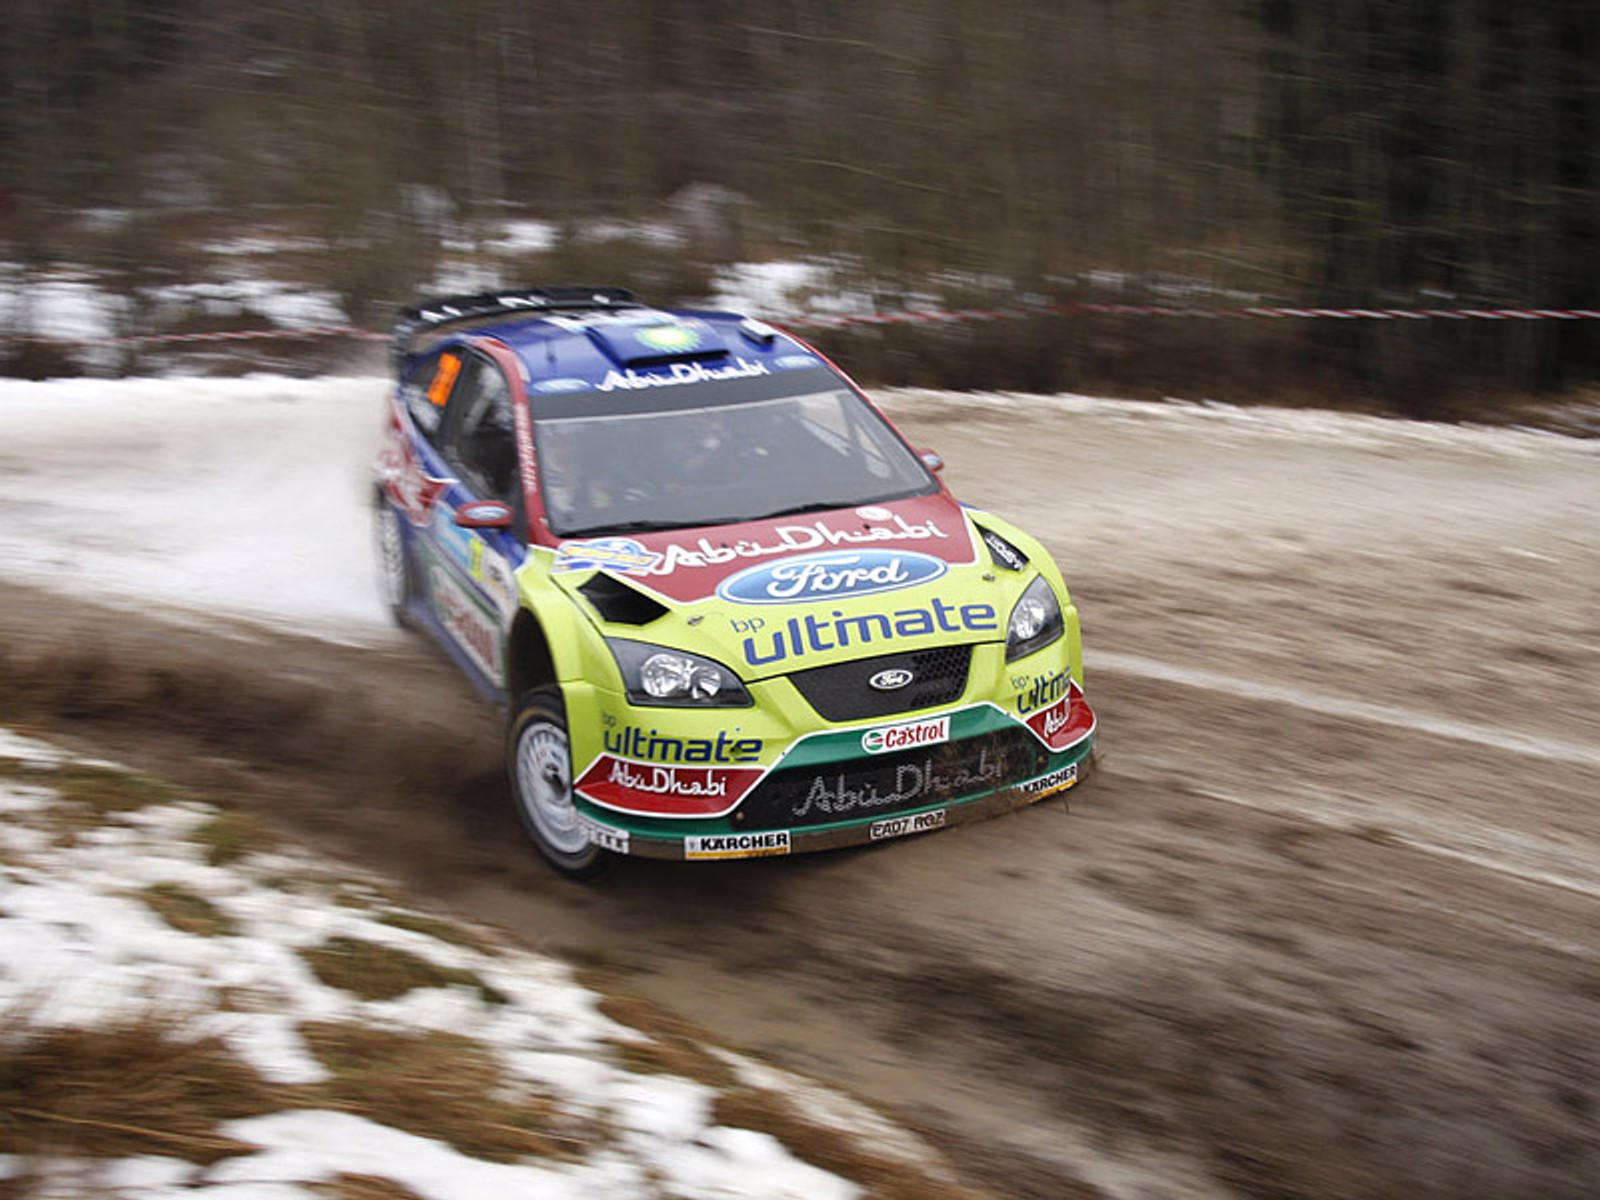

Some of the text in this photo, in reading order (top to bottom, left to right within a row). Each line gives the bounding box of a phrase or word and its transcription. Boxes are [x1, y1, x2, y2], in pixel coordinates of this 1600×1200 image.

[766, 557, 909, 597] Ford
[730, 617, 765, 633] bp
[743, 598, 997, 666] ultimate
[605, 727, 763, 762] ultimate
[885, 720, 944, 748] Castrol
